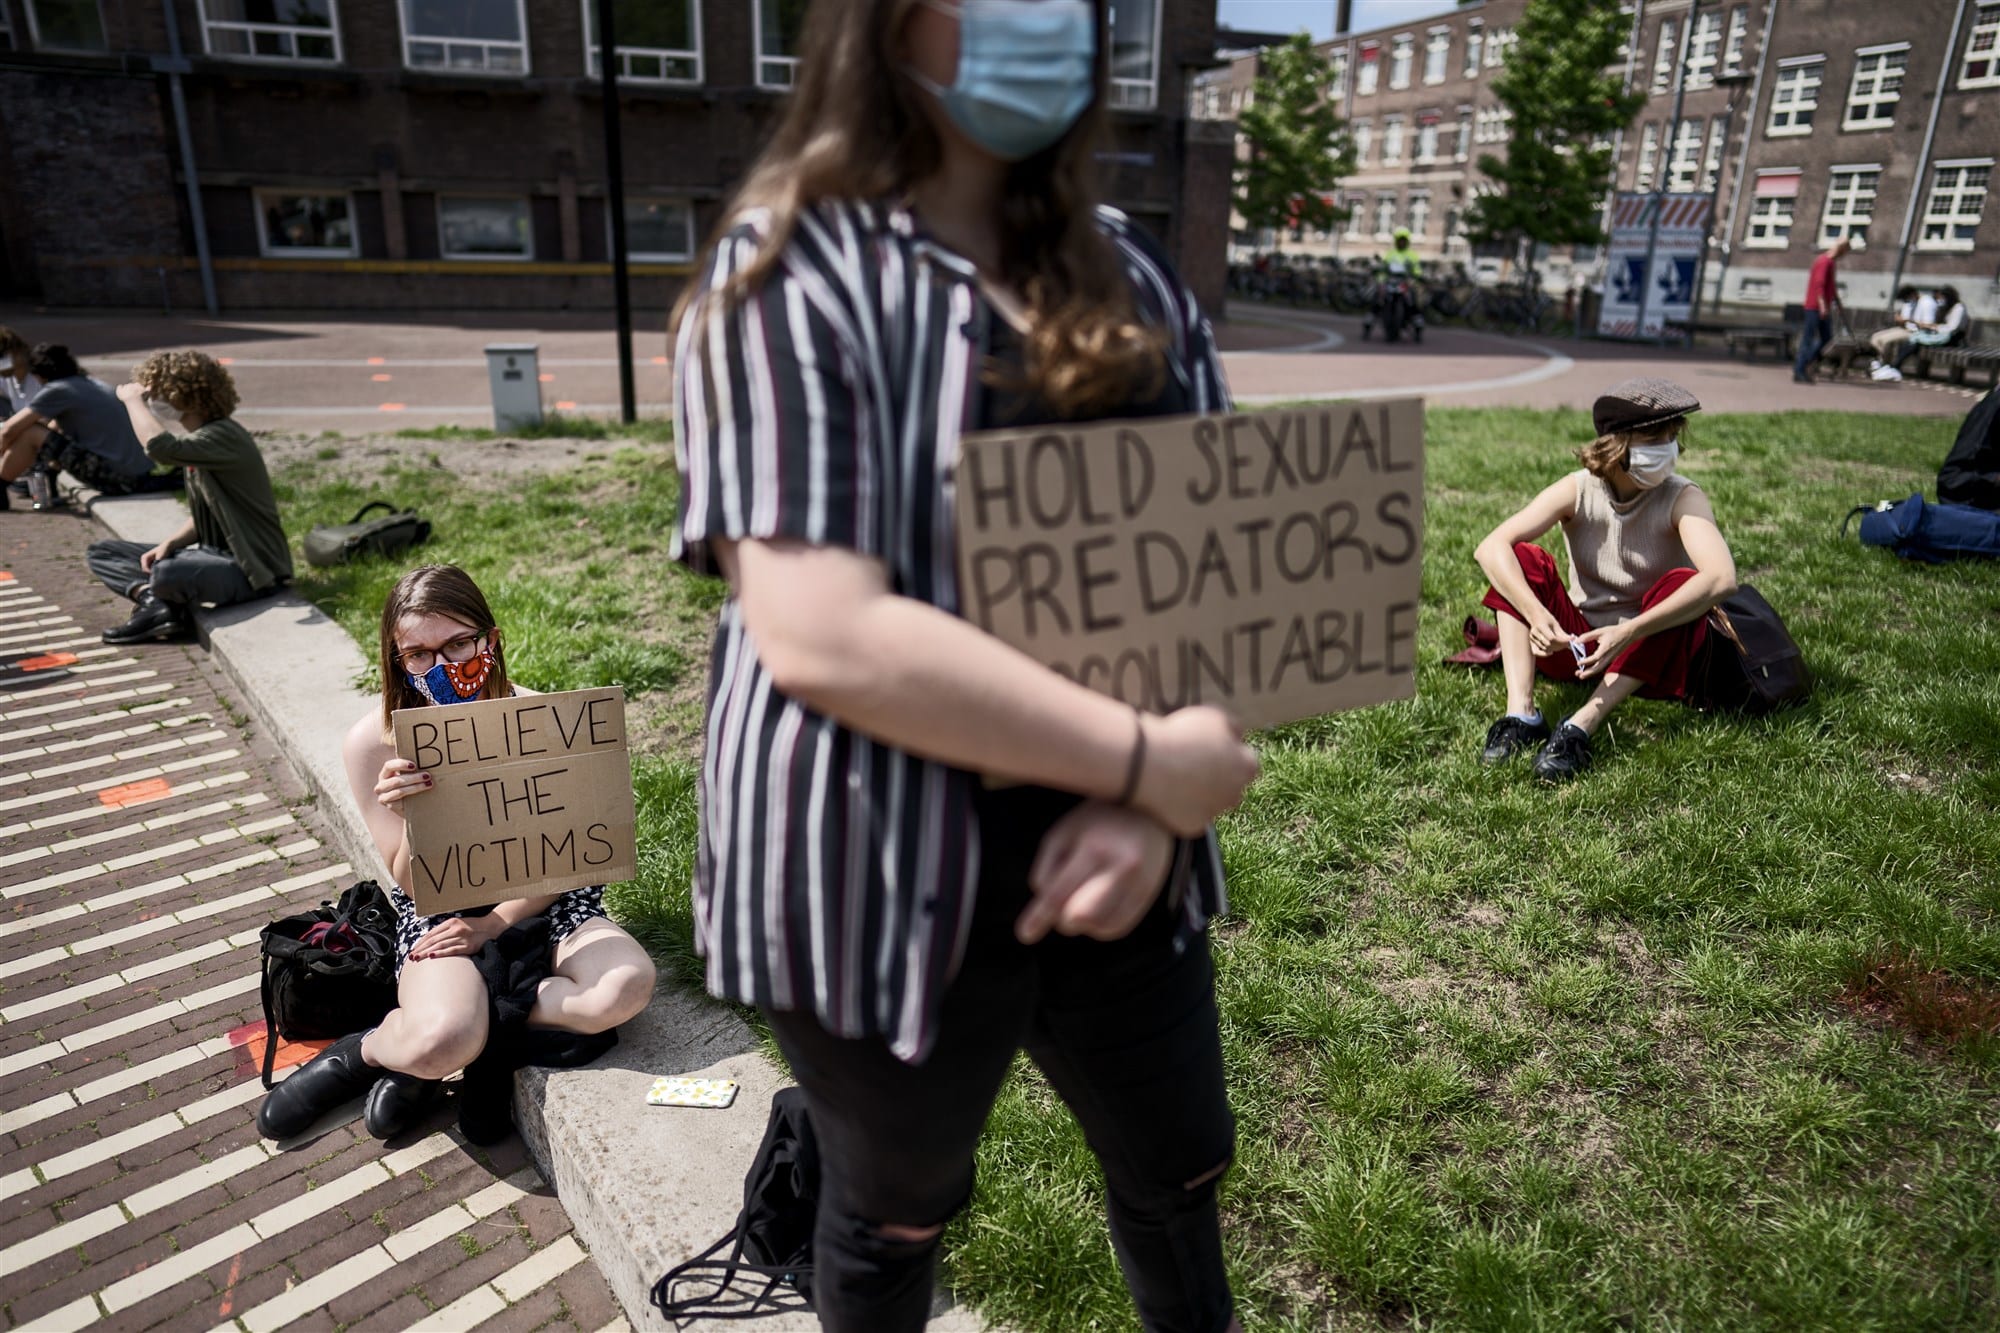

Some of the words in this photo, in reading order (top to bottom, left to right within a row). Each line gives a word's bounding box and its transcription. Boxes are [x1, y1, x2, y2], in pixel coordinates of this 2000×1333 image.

[968, 430, 1155, 531] HOLD
[1186, 404, 1415, 505] SEXUAL
[970, 491, 1418, 638] PREDATORS
[413, 697, 618, 769] BELIEVE
[467, 768, 568, 826] THE
[418, 823, 614, 894] VICTIMS
